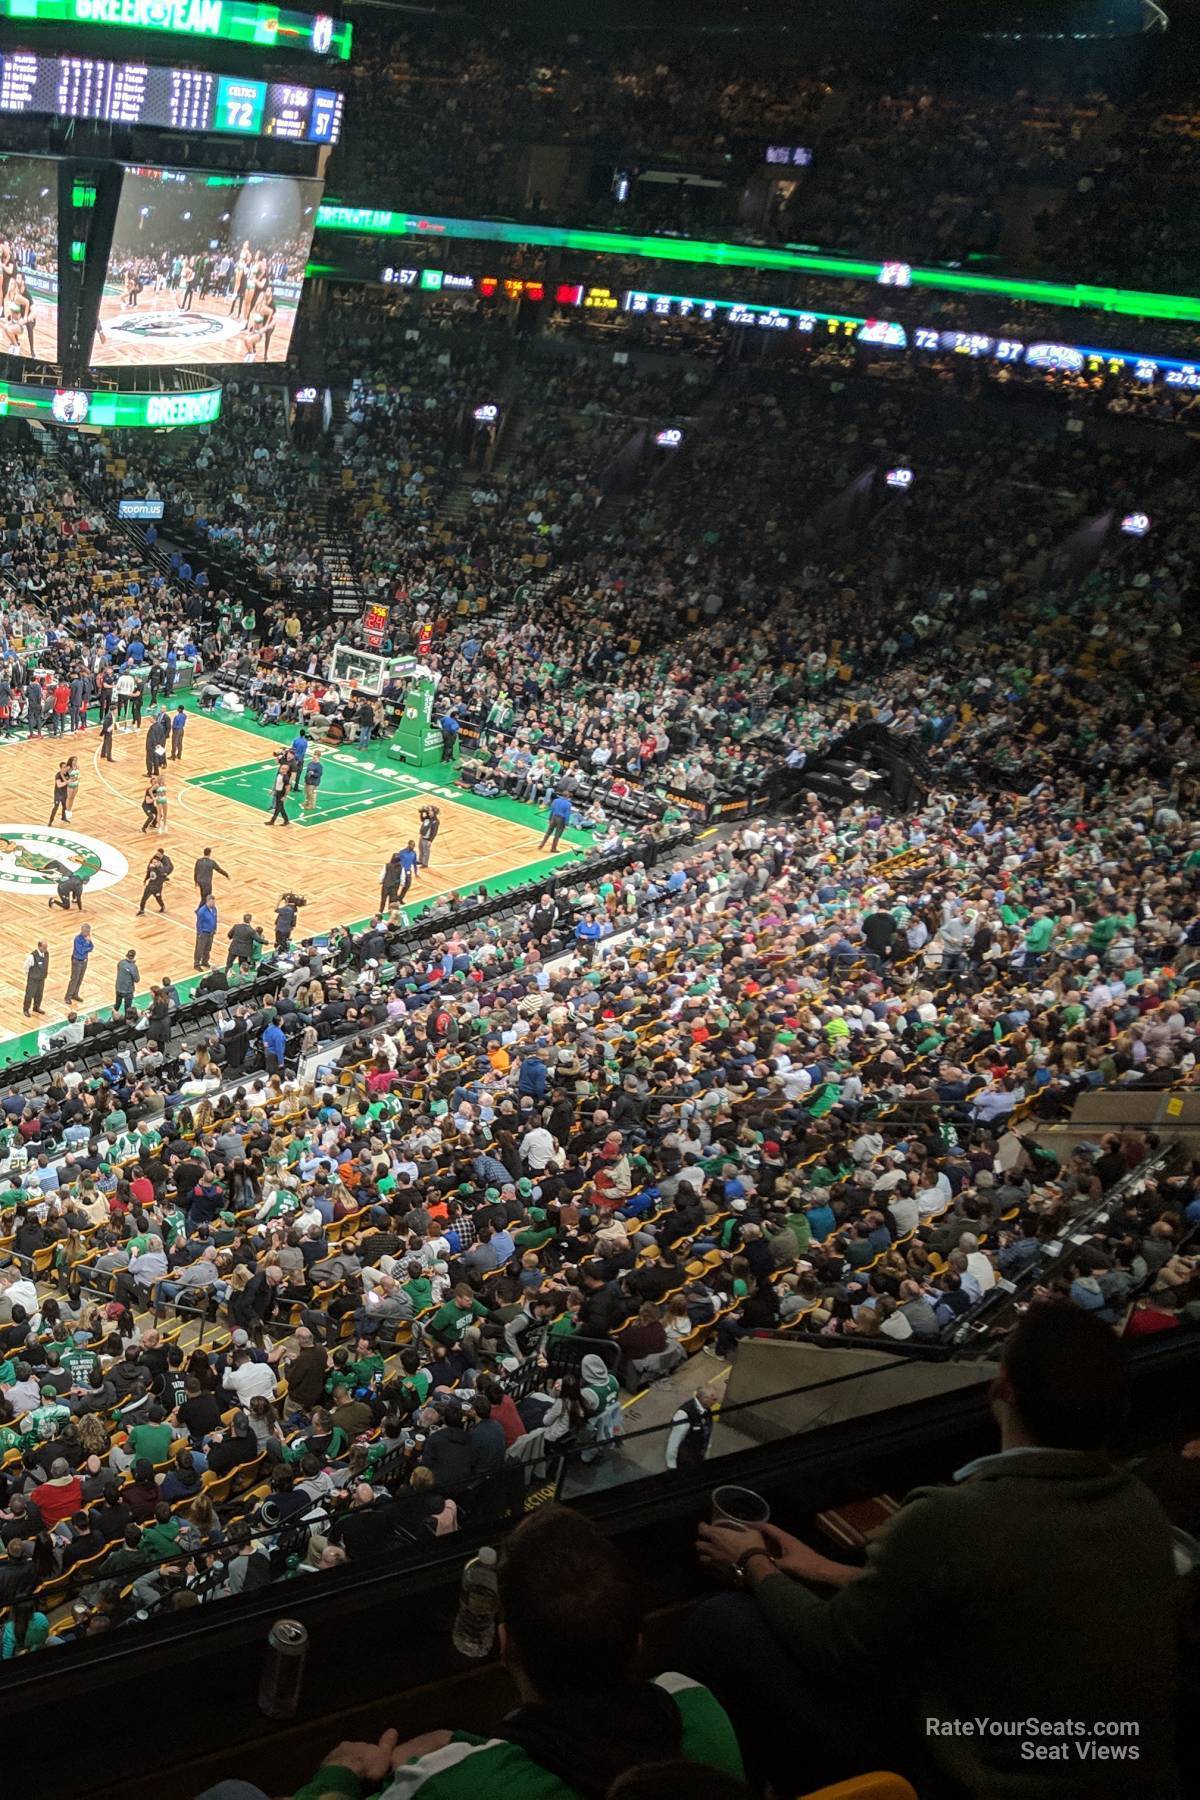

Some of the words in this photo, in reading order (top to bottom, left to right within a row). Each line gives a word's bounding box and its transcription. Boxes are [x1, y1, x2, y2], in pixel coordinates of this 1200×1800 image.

[76, 0, 147, 27] GREEN
[165, 2, 220, 34] TEAM
[228, 86, 257, 98] CELTICS
[283, 88, 308, 106] 7:56
[227, 102, 253, 126] 72
[315, 113, 330, 135] 57
[358, 209, 391, 228] TEAM
[383, 268, 417, 284] 8:57
[443, 275, 473, 287] Bank
[656, 304, 668, 313] 12
[915, 330, 939, 348] 72
[954, 333, 989, 349] 7:56
[996, 342, 1023, 360] 57
[304, 387, 317, 400] 10
[147, 395, 193, 424] GREEN
[483, 405, 497, 416] 10
[667, 429, 681, 441] 10
[896, 469, 912, 483] 10
[122, 504, 161, 514] zoom.us
[1133, 514, 1148, 529] 10
[367, 613, 385, 629] 24
[332, 753, 462, 798] GARDEN
[666, 792, 706, 812] GARDEN
[21, 832, 92, 857] CELTICS
